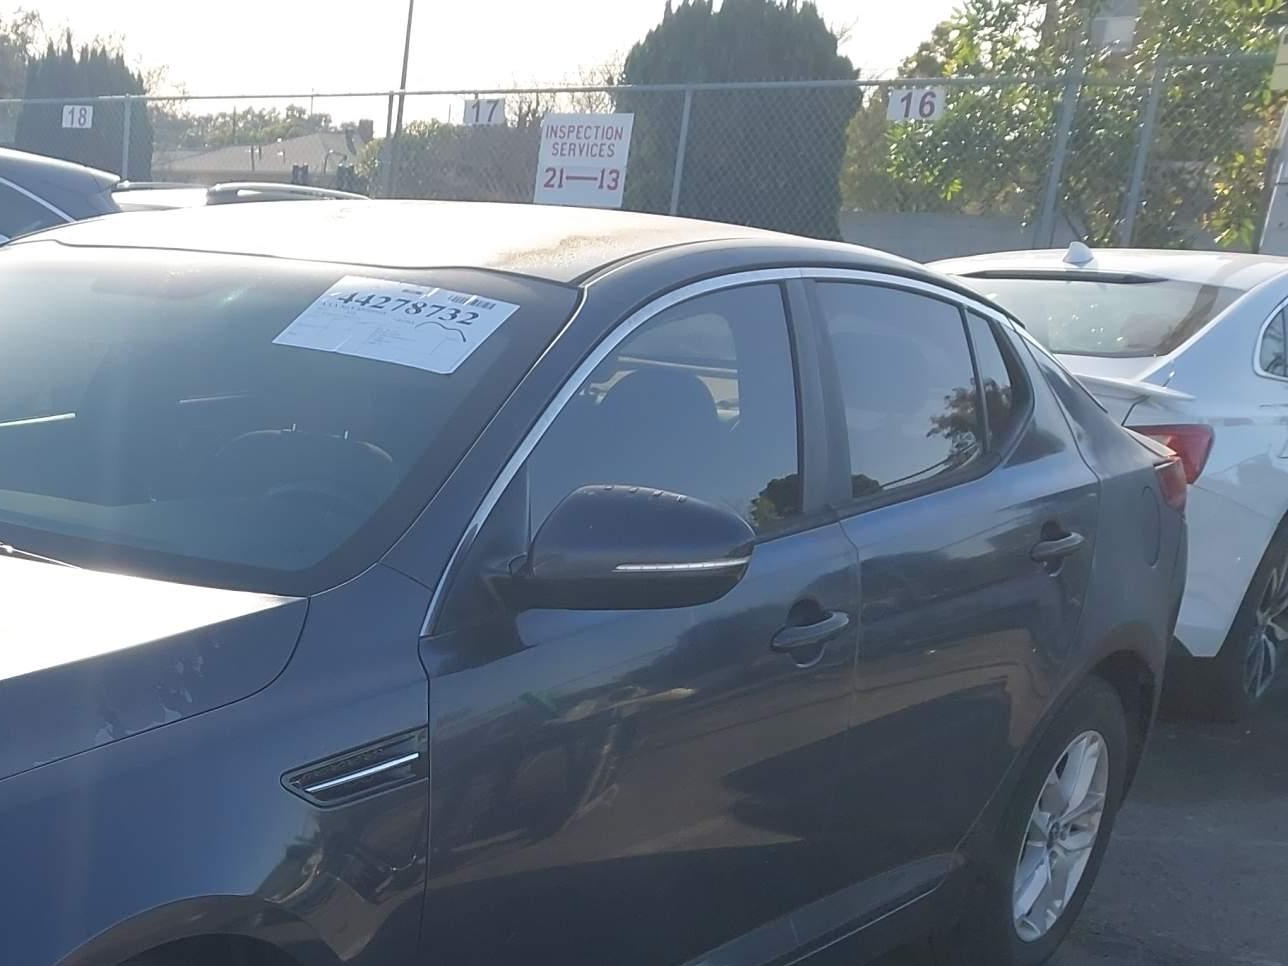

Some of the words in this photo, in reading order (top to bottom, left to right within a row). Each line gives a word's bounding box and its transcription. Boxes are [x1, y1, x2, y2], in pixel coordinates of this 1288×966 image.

[471, 99, 500, 123] 17
[900, 91, 936, 118] 16
[67, 106, 87, 126] 18
[545, 124, 624, 141] INSPECTION
[551, 142, 616, 158] SERVICES
[337, 291, 480, 326] 44278732
